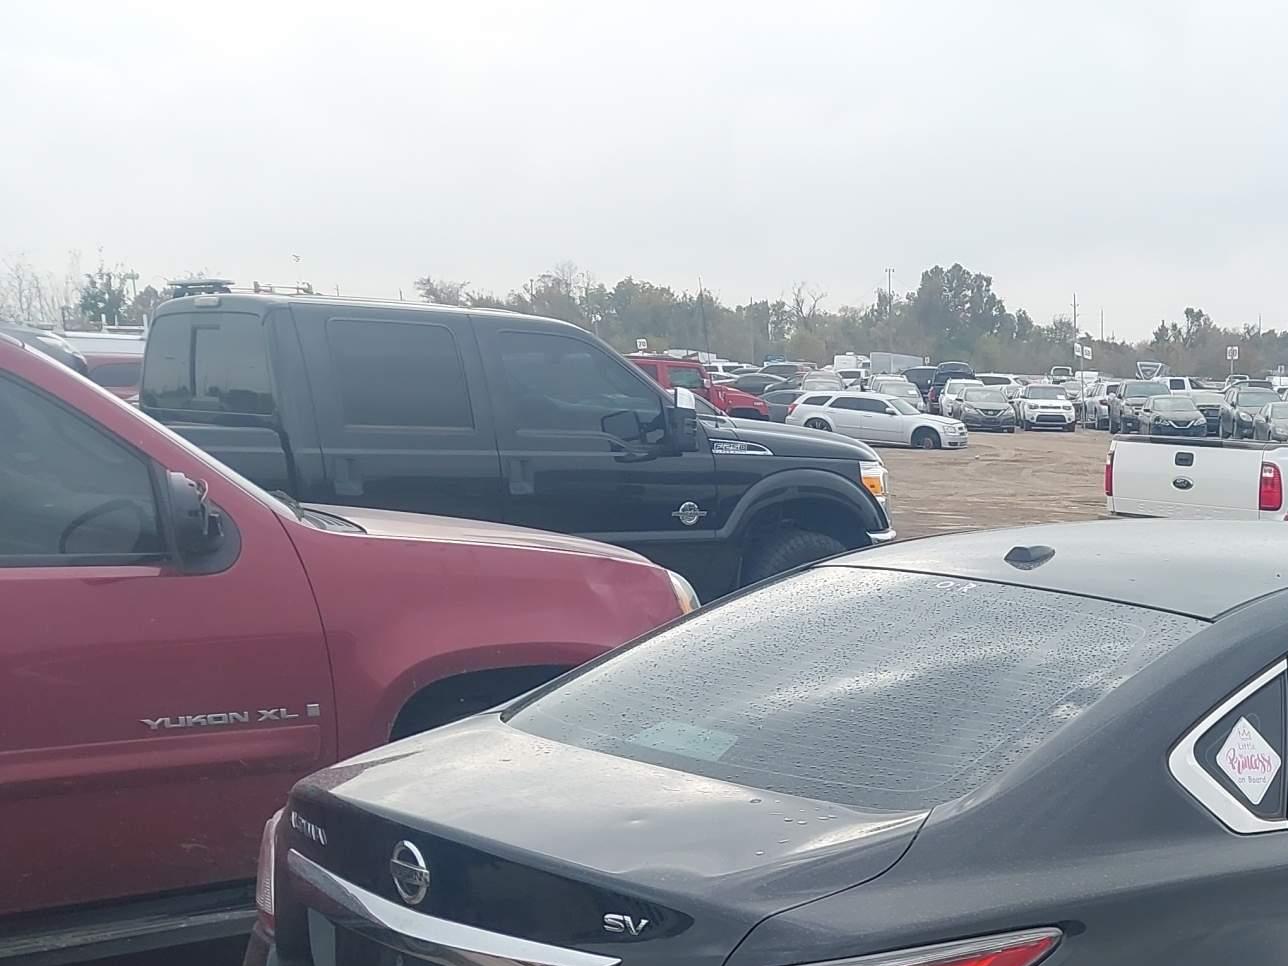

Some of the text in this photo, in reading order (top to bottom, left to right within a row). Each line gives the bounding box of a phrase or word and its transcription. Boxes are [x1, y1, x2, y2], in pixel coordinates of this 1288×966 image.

[140, 708, 300, 730] YUKON XL
[603, 913, 649, 936] SV
